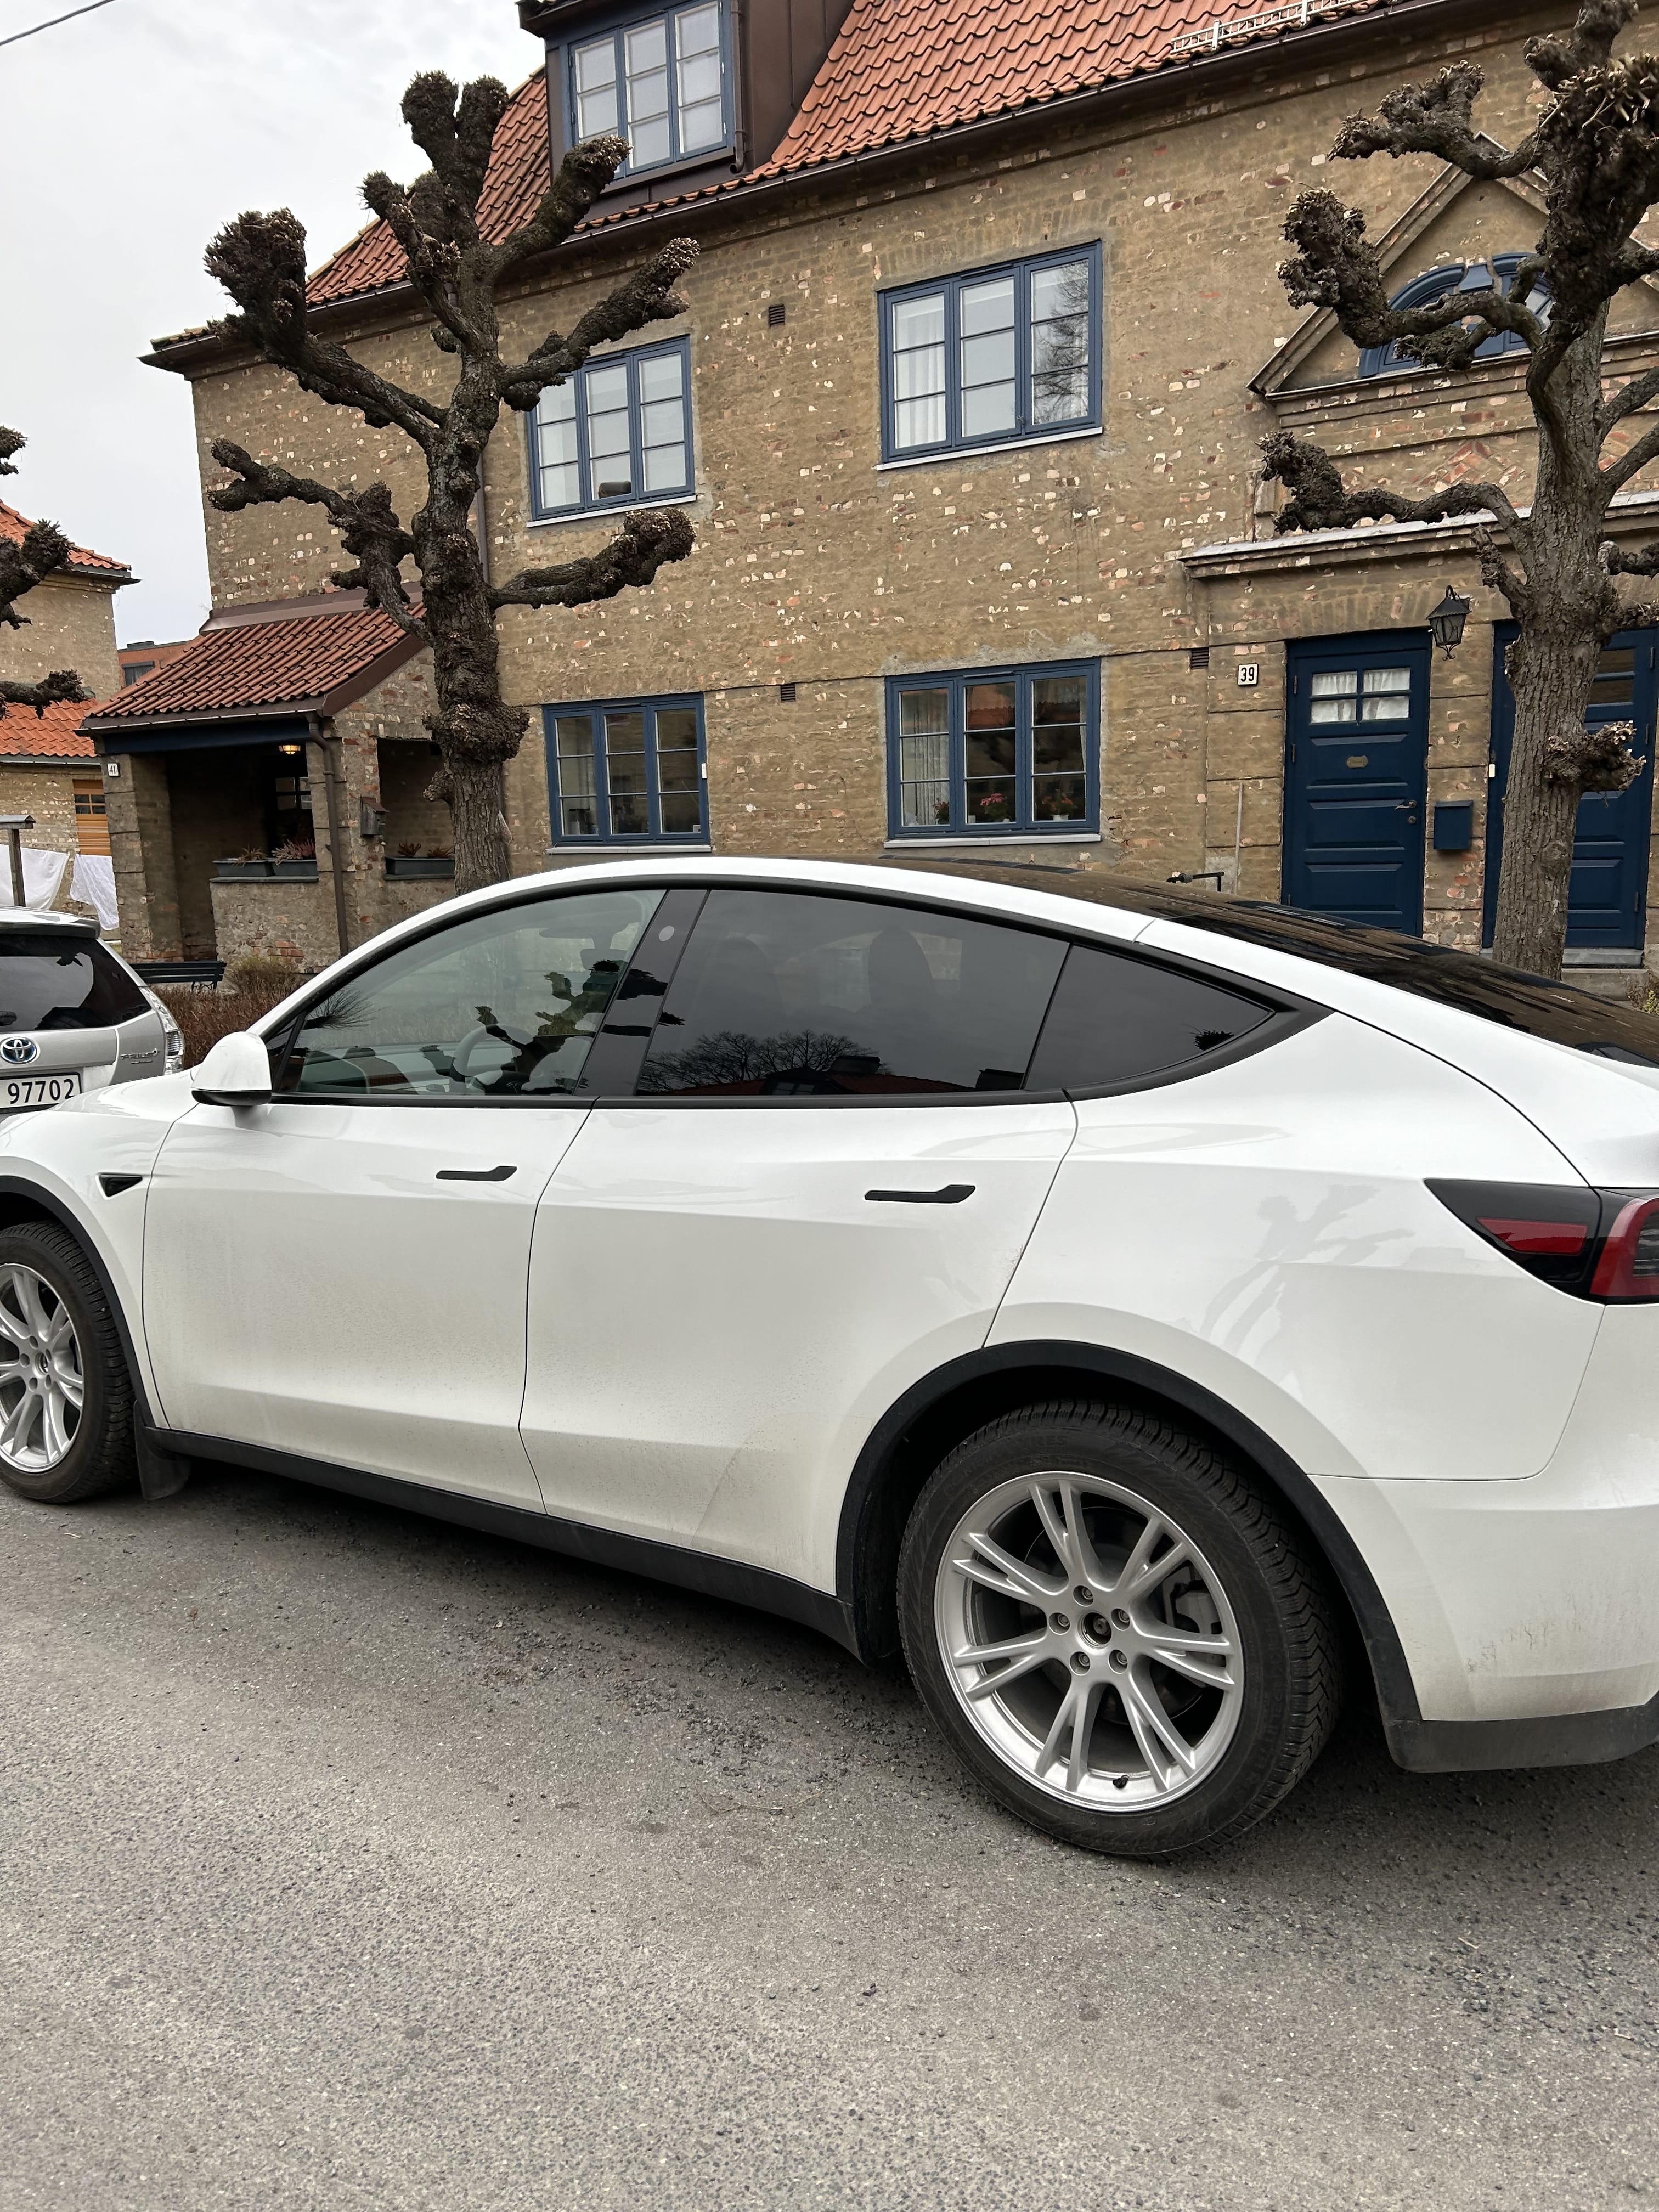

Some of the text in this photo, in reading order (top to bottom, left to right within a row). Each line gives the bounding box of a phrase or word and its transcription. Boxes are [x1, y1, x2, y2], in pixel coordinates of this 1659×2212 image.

[1241, 667, 1255, 682] 39
[110, 765, 116, 775] 41
[8, 1079, 76, 1104] 97702
